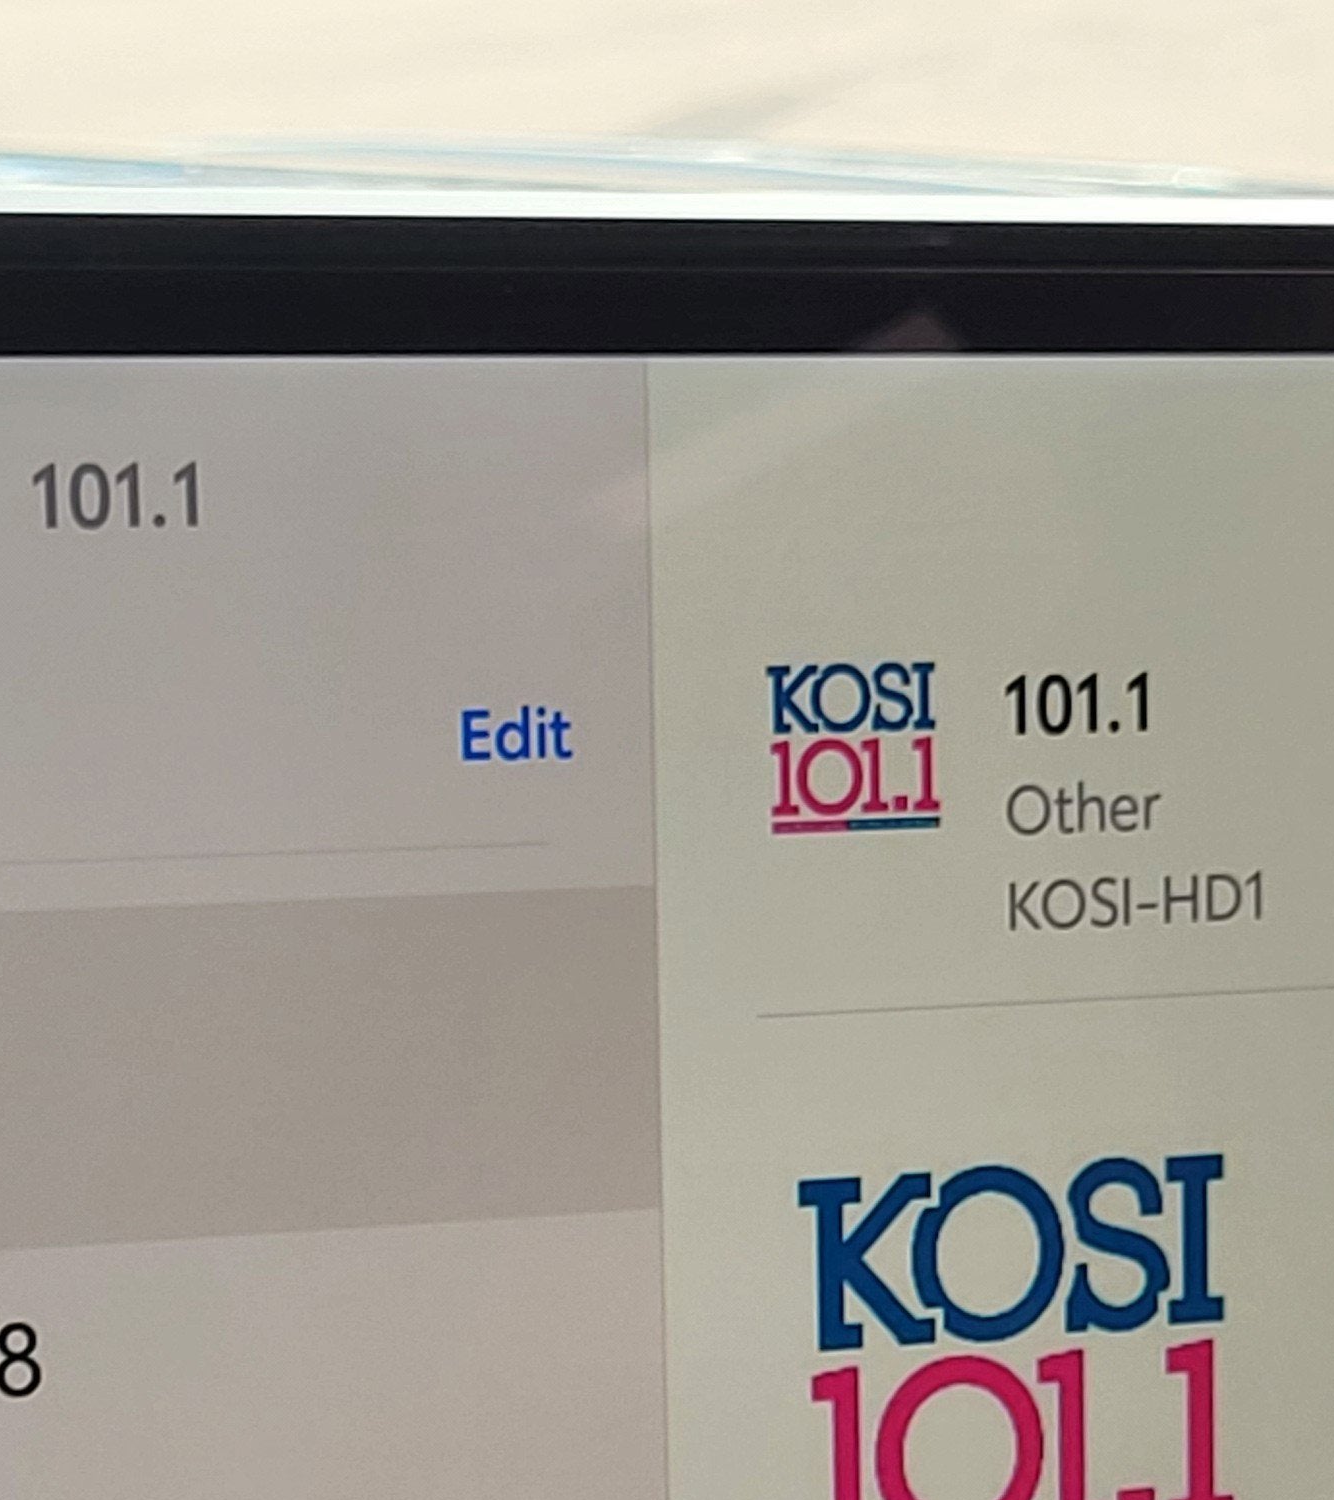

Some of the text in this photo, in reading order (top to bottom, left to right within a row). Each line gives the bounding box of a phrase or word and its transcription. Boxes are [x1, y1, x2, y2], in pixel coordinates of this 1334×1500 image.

[30, 461, 201, 530] 101.1
[766, 662, 935, 734] KOSI
[1004, 672, 1149, 735] 101.1
[460, 705, 573, 763] Edit
[771, 737, 940, 816] 101.1
[1007, 782, 1162, 836] Other
[1009, 871, 1263, 930] KOSI-HD1
[798, 1153, 1224, 1351] KOSI
